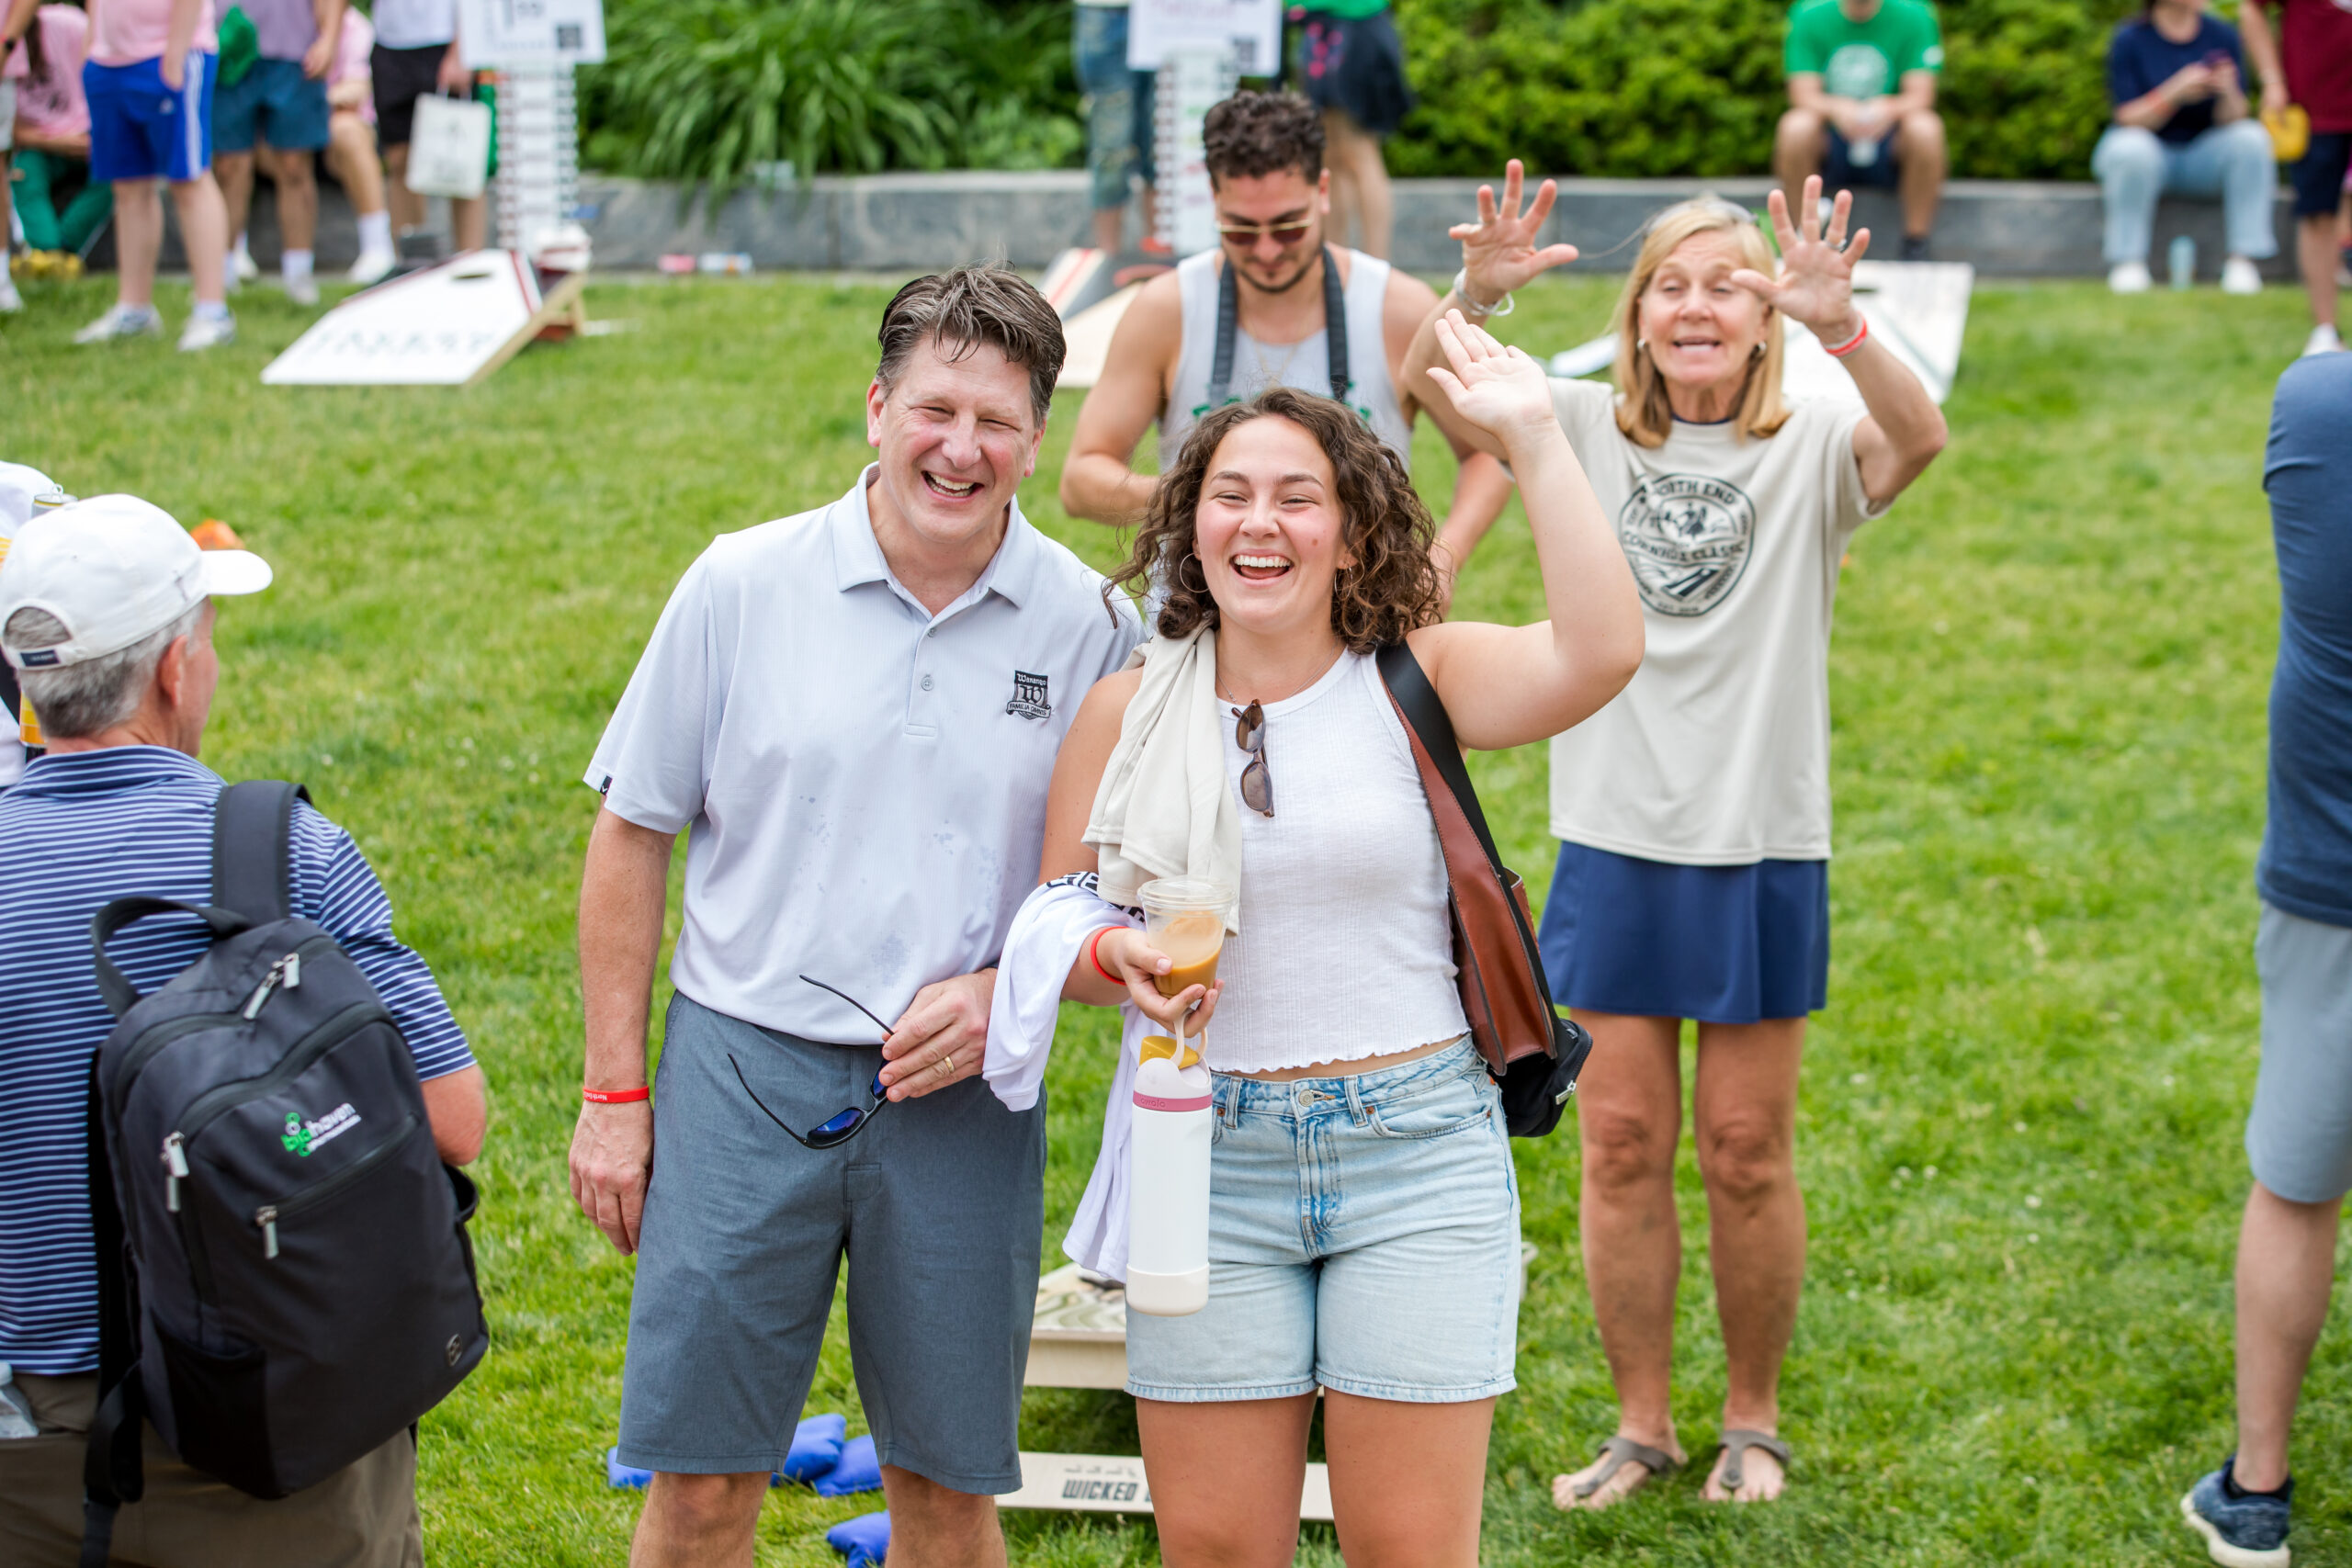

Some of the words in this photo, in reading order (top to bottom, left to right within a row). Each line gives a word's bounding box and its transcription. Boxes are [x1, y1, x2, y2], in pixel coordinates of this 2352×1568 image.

[1653, 480, 1698, 496] ORTH
[1703, 483, 1736, 505] END
[1009, 703, 1030, 711] FAMILIA
[1031, 706, 1046, 716] OMNIS
[1061, 1479, 1138, 1502] WICKED
